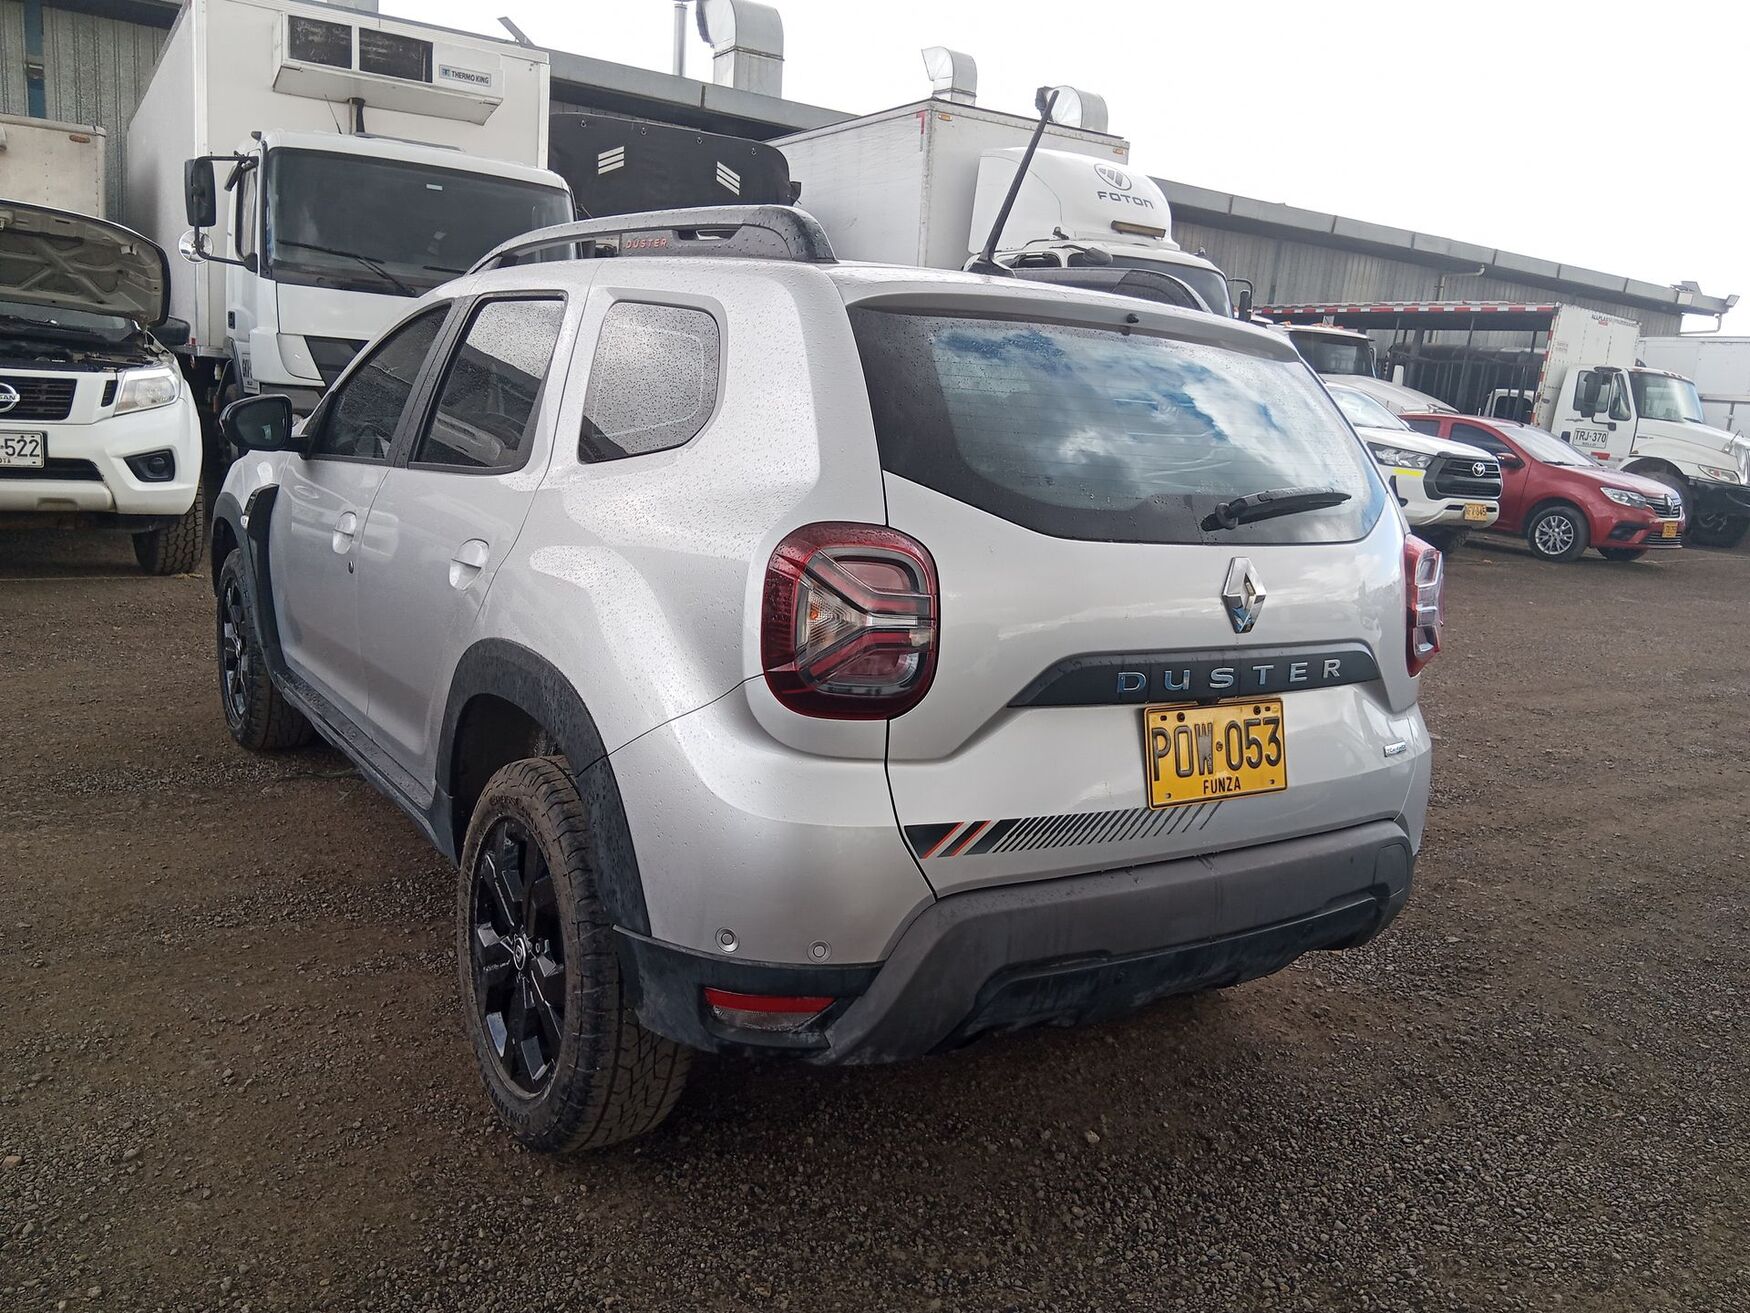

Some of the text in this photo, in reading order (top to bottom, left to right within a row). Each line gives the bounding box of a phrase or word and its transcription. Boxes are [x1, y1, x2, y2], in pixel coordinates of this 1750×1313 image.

[451, 70, 475, 82] THERMO
[475, 75, 489, 85] KING
[1097, 191, 1154, 210] FOTON
[625, 238, 668, 249] DUSTER
[1116, 658, 1342, 695] DUSTER
[1203, 775, 1242, 795] FUNZA
